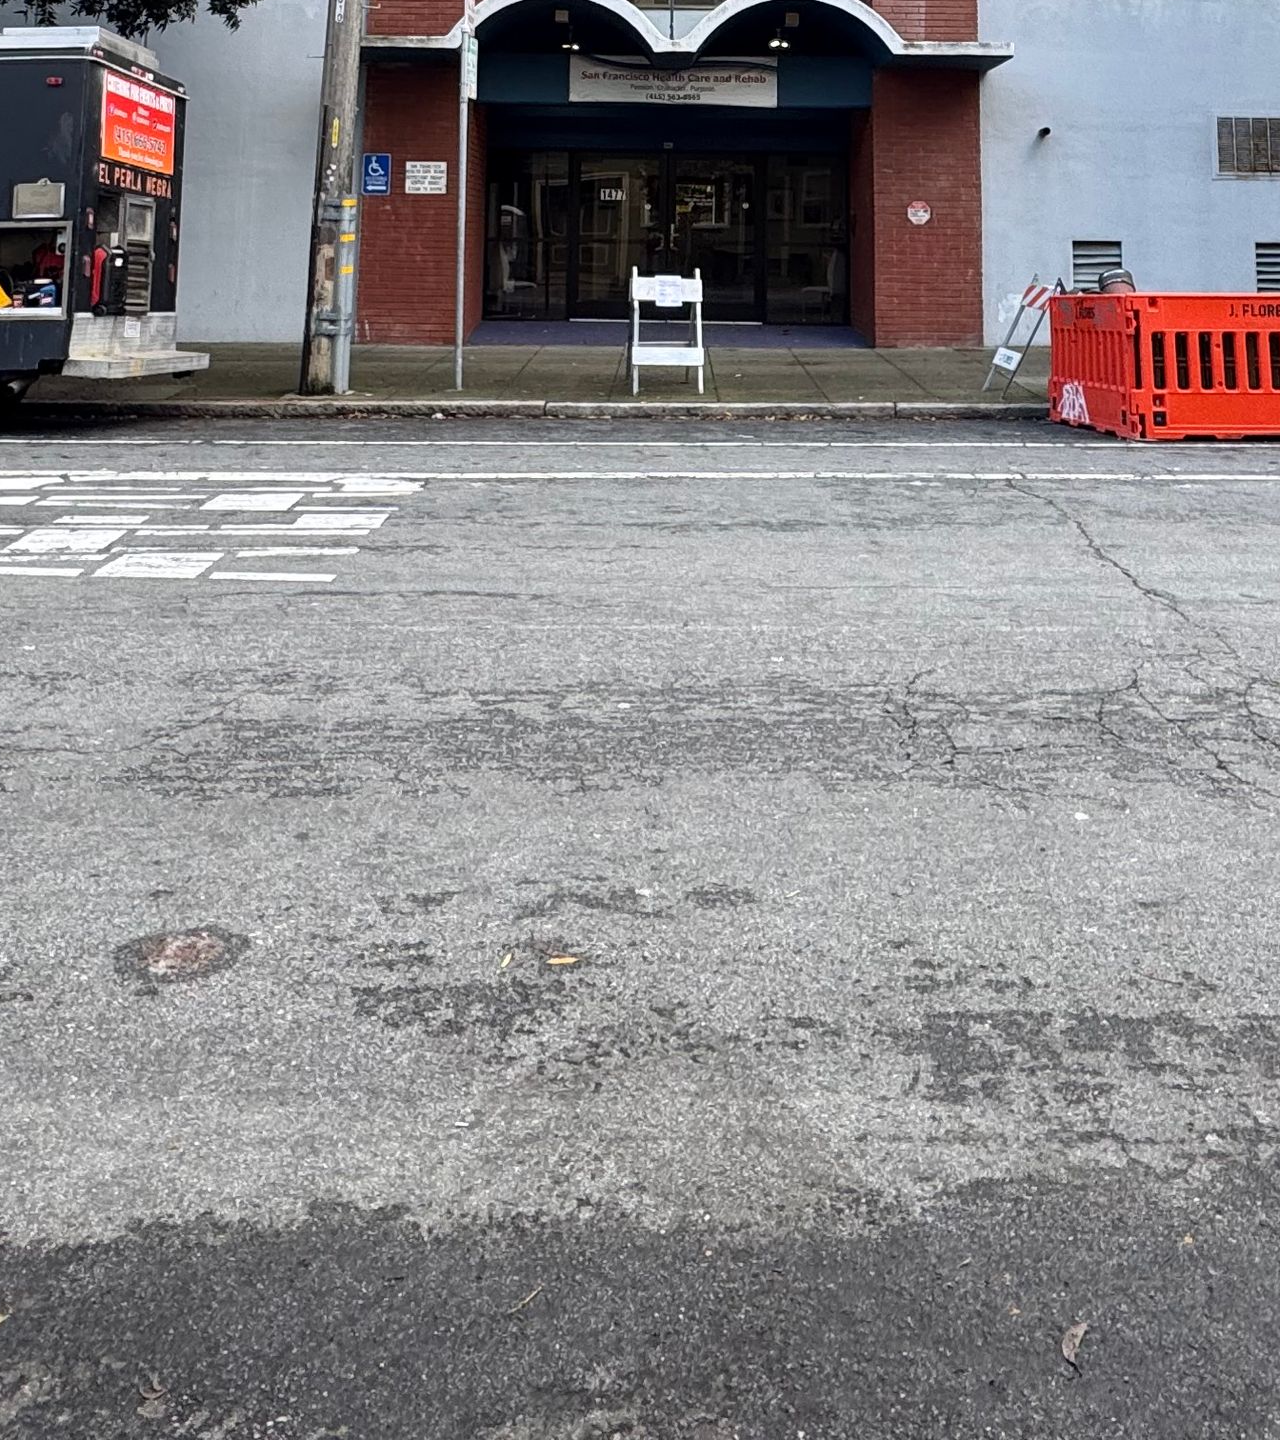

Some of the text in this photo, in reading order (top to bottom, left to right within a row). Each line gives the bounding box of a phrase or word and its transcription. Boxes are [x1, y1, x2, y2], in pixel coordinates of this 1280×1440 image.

[581, 70, 767, 84] San Francisco Health Care and Rehab
[98, 162, 173, 200] EL PERLA NEGRA
[1229, 303, 1238, 318] J.
